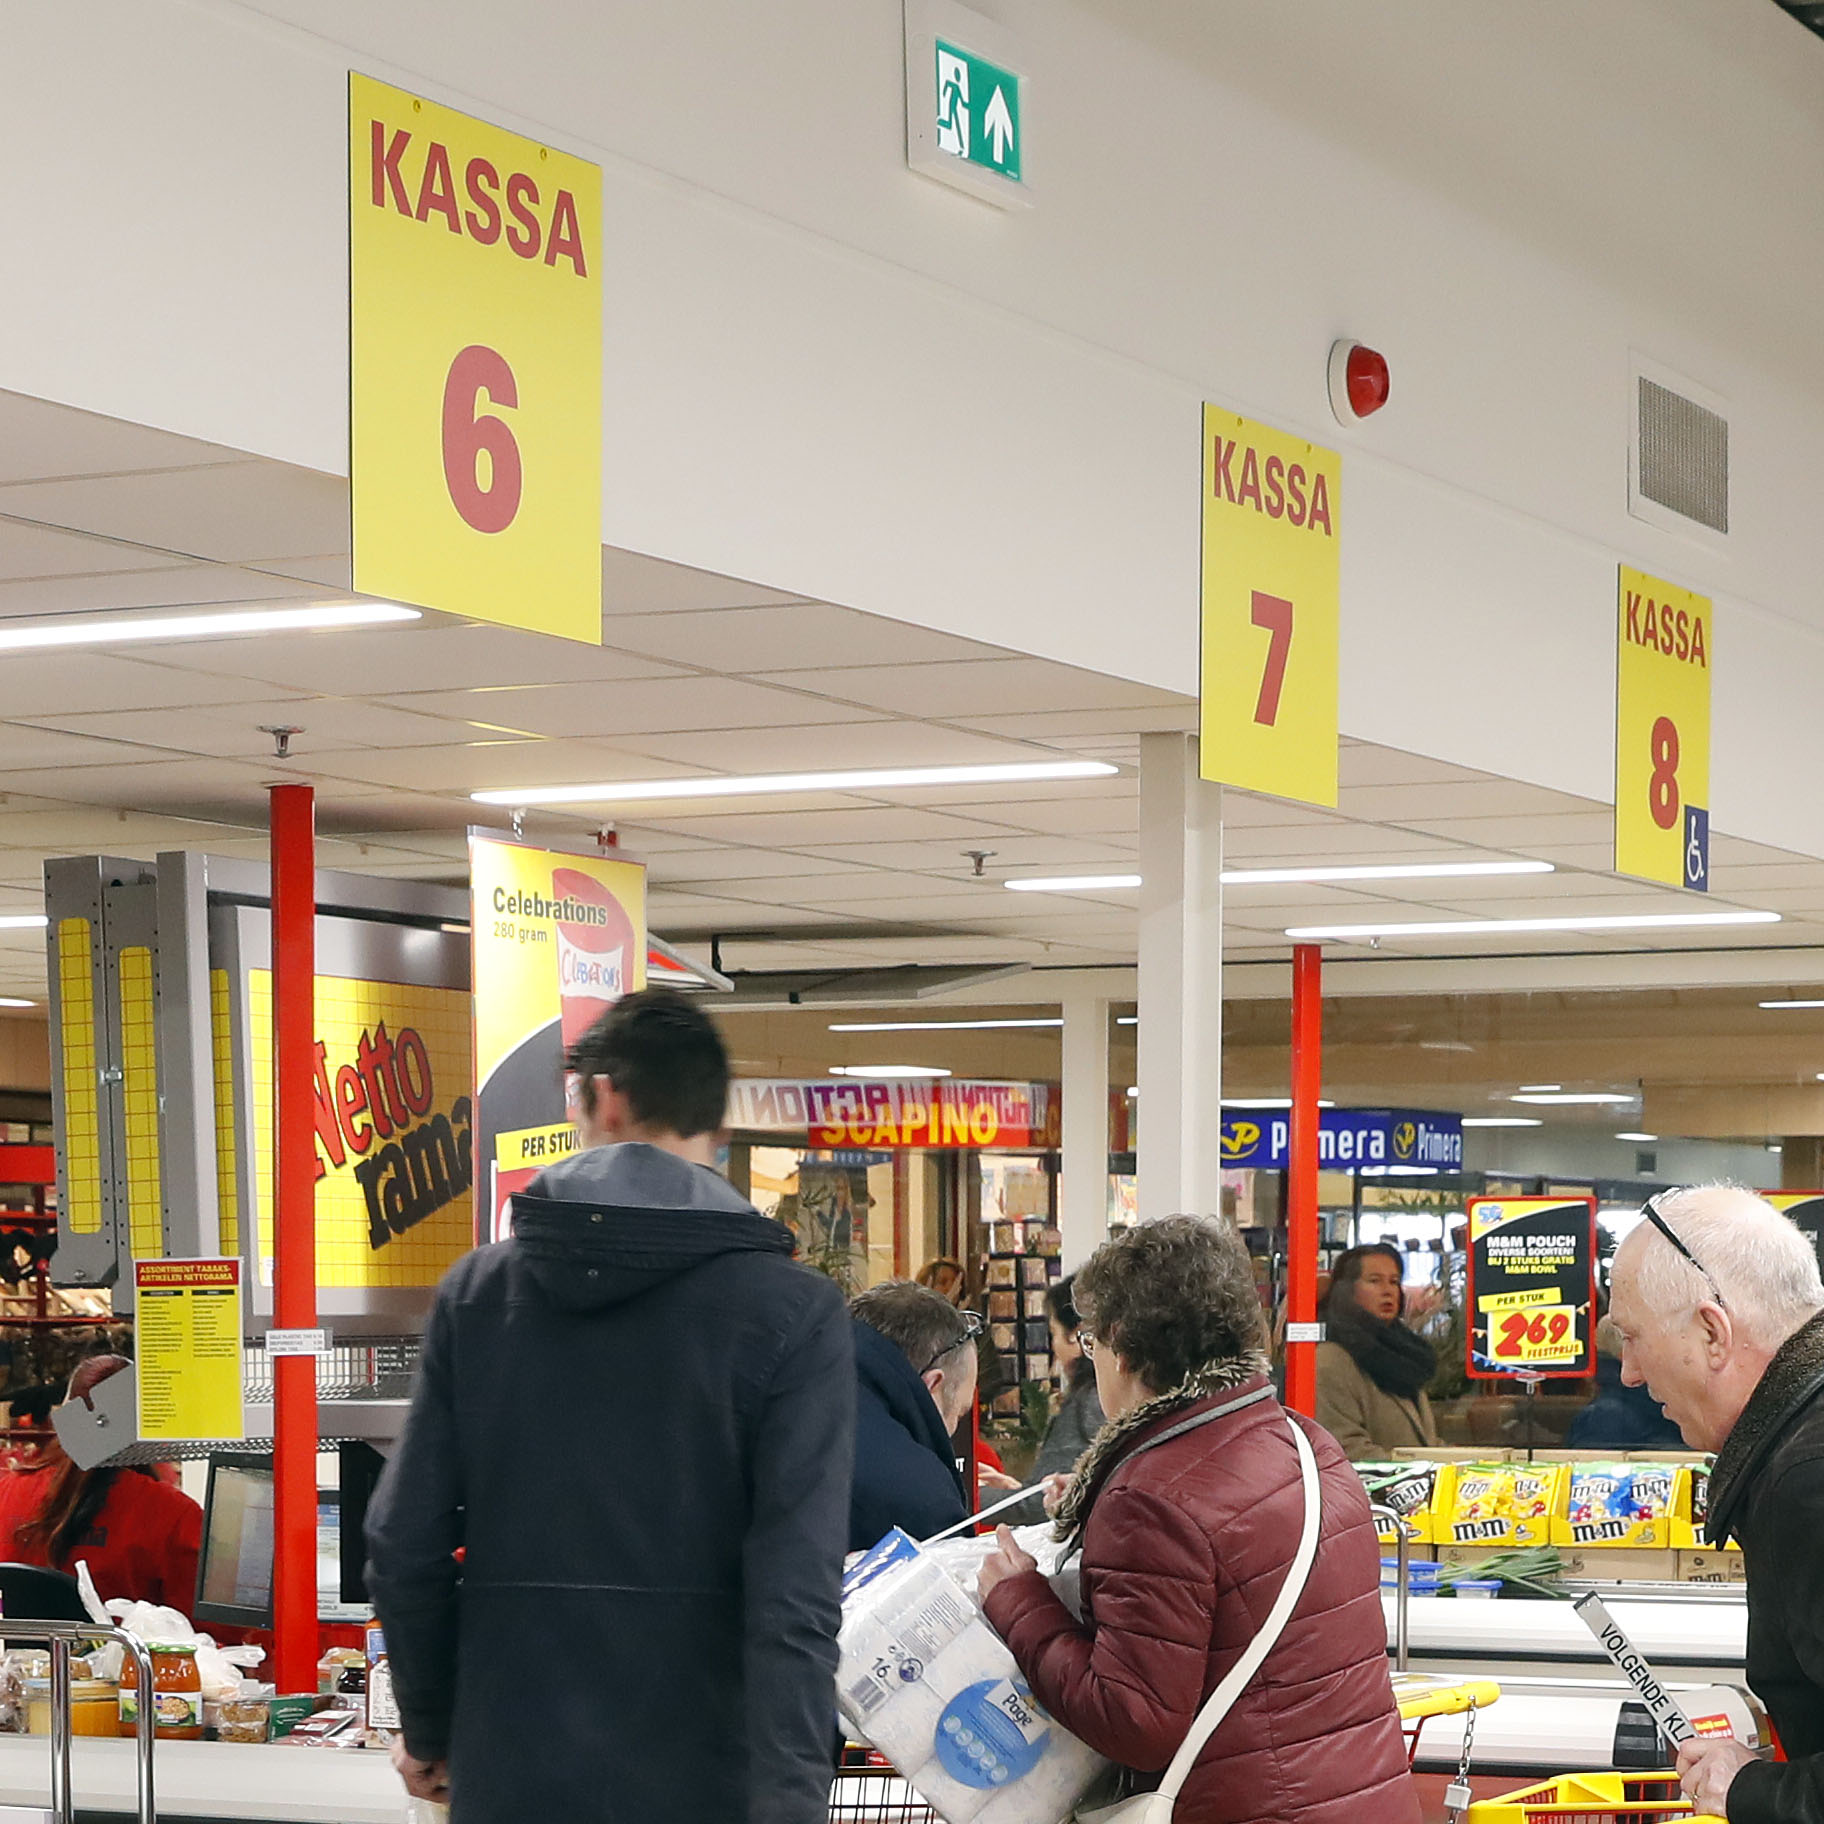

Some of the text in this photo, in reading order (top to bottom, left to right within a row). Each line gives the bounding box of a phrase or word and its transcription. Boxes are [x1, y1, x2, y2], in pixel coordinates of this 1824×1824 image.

[370, 119, 588, 279] KASSA
[441, 344, 523, 535] 6
[1213, 436, 1332, 537] KASSA
[1625, 590, 1707, 669] KASSA
[1250, 589, 1294, 728] 7
[1649, 715, 1680, 831] 8
[493, 886, 607, 926] Celebrations
[493, 921, 548, 944] 280 gram
[314, 1020, 434, 1184] Netto
[821, 1101, 999, 1145] SCAPINO
[521, 1132, 545, 1158] PER
[1271, 1120, 1386, 1161] Pmera
[1417, 1122, 1462, 1163] Primera
[1486, 1235, 1577, 1249] M&M POUCH
[1541, 1256, 1575, 1265] GRATIS
[1496, 1293, 1545, 1306] PER STUK
[1495, 1312, 1570, 1357] 269
[871, 1657, 891, 1679] 16
[1599, 1623, 1670, 1713] VOLGENDE
[1002, 1692, 1033, 1728] Page
